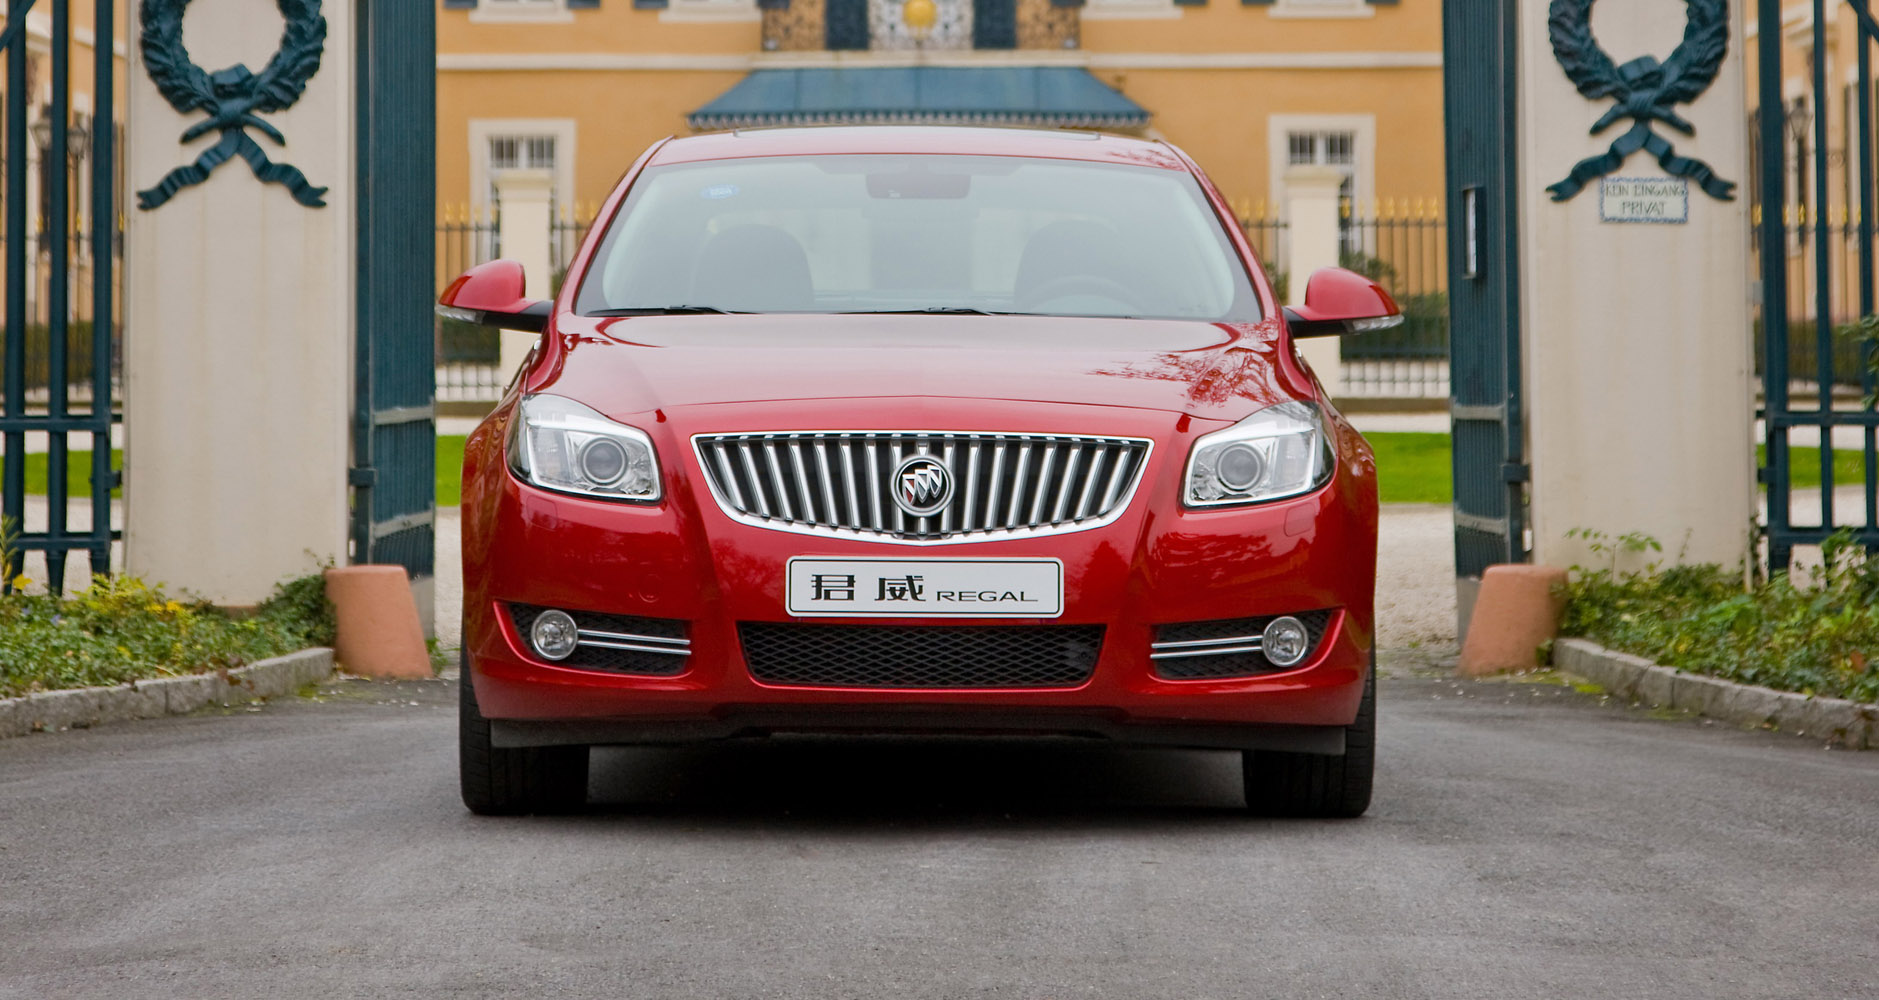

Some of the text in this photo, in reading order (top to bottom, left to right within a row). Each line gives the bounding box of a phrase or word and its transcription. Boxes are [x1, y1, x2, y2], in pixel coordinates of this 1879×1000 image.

[1605, 183, 1686, 198] KEIN EINGANG
[1622, 199, 1667, 215] PRIVAT
[936, 590, 1039, 602] REGAL
